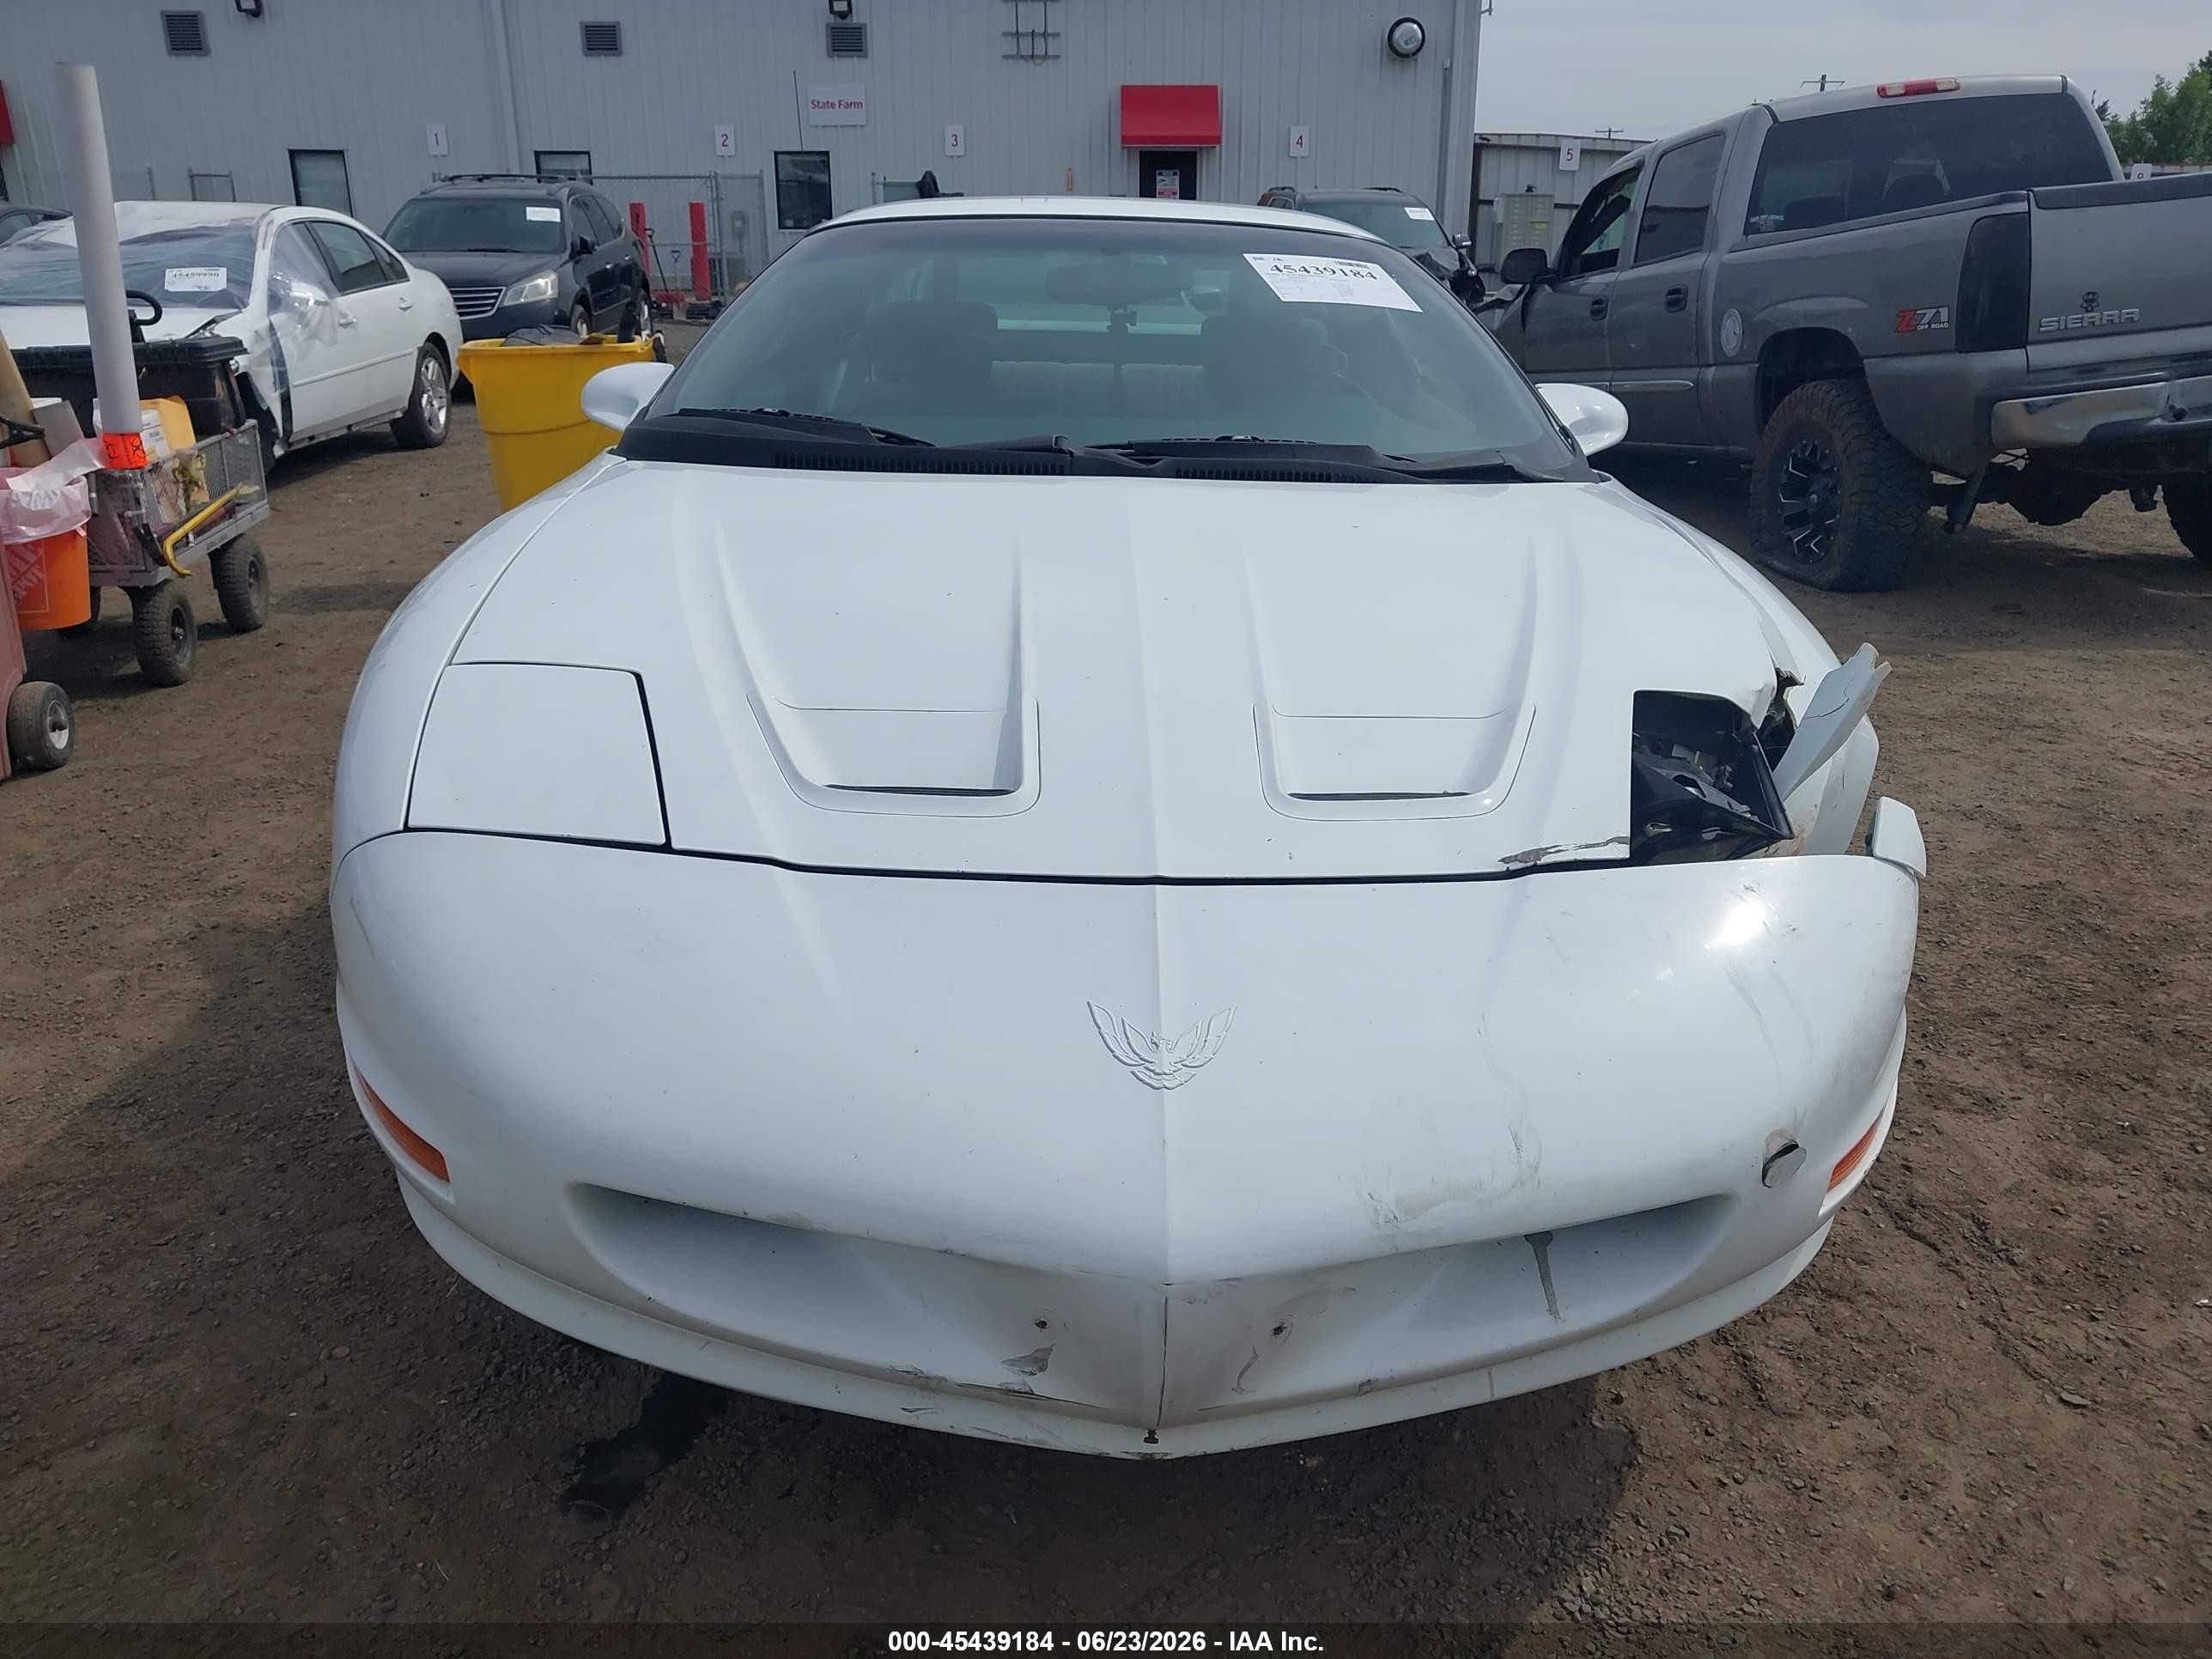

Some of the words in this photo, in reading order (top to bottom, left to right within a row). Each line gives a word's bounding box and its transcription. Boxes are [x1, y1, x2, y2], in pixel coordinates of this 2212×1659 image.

[810, 99, 836, 110] State
[838, 99, 864, 110] Farm
[721, 133, 729, 147] 2
[951, 133, 958, 147] 3
[1296, 134, 1304, 149] 4
[1566, 148, 1574, 161] 5
[1270, 264, 1377, 280] 45439184
[1894, 307, 1949, 332] Z71
[2039, 308, 2140, 332] SIERRA
